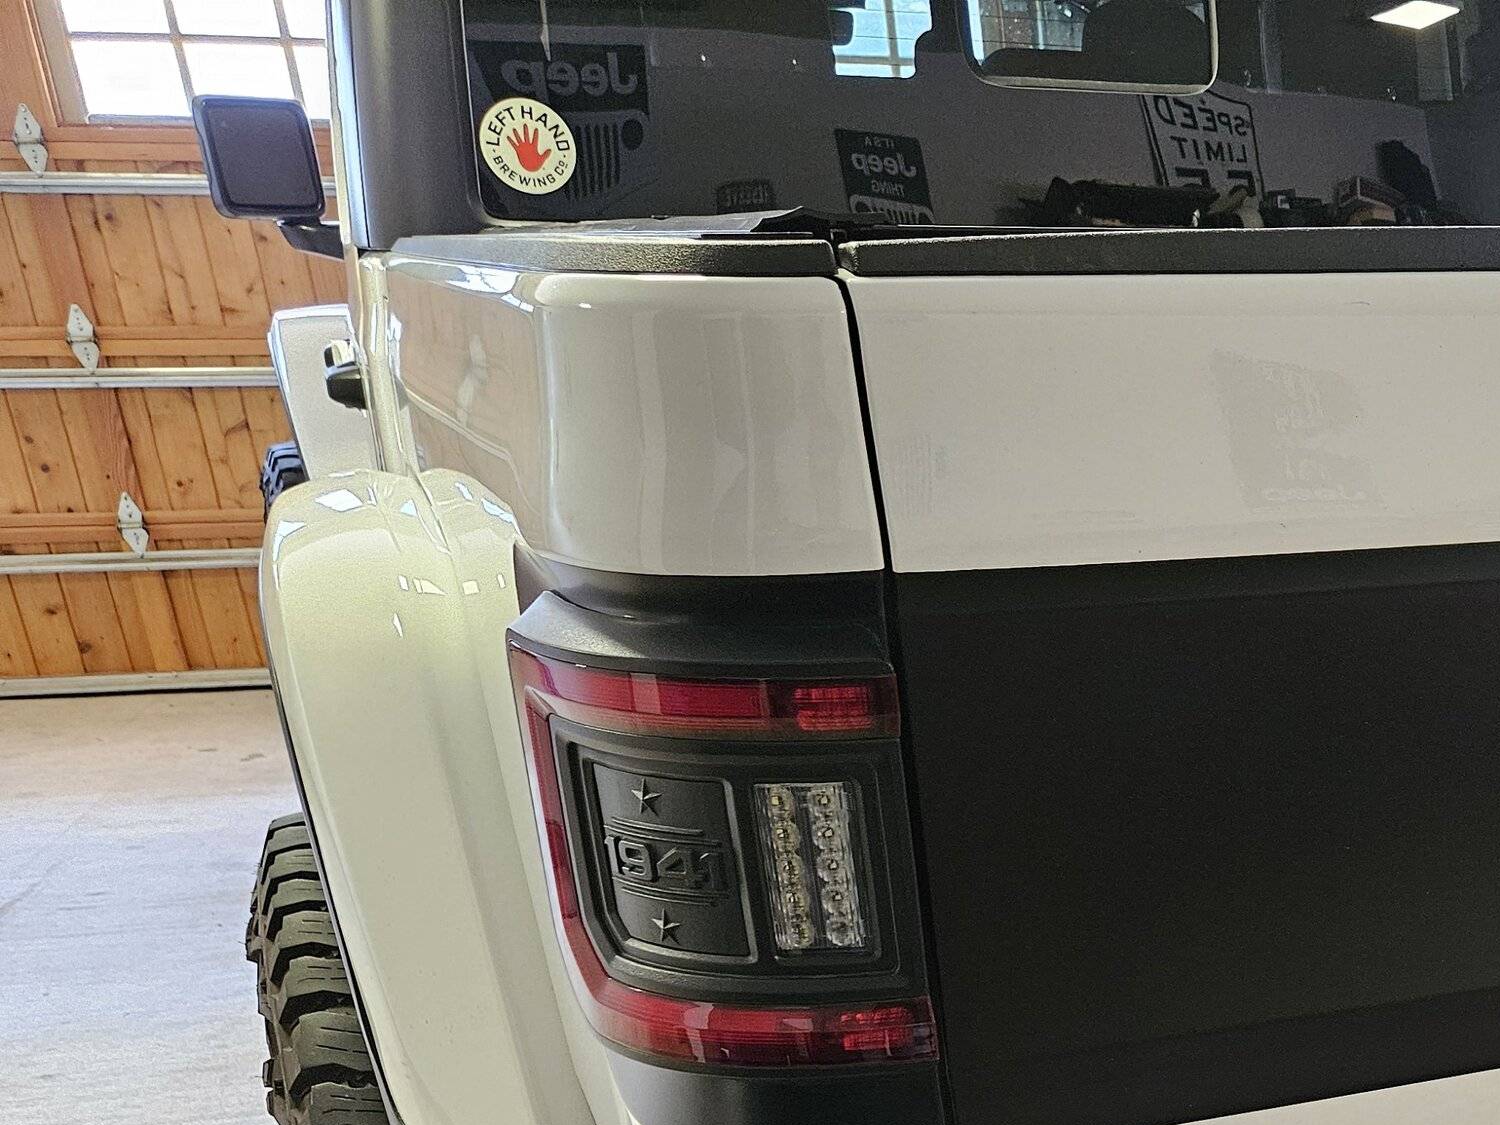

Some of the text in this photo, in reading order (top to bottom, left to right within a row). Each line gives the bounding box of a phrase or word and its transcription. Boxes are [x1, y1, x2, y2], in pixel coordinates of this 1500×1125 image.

[486, 105, 570, 151] LEFT HAND
[493, 155, 556, 188] BREWING
[604, 835, 724, 889] 1941
